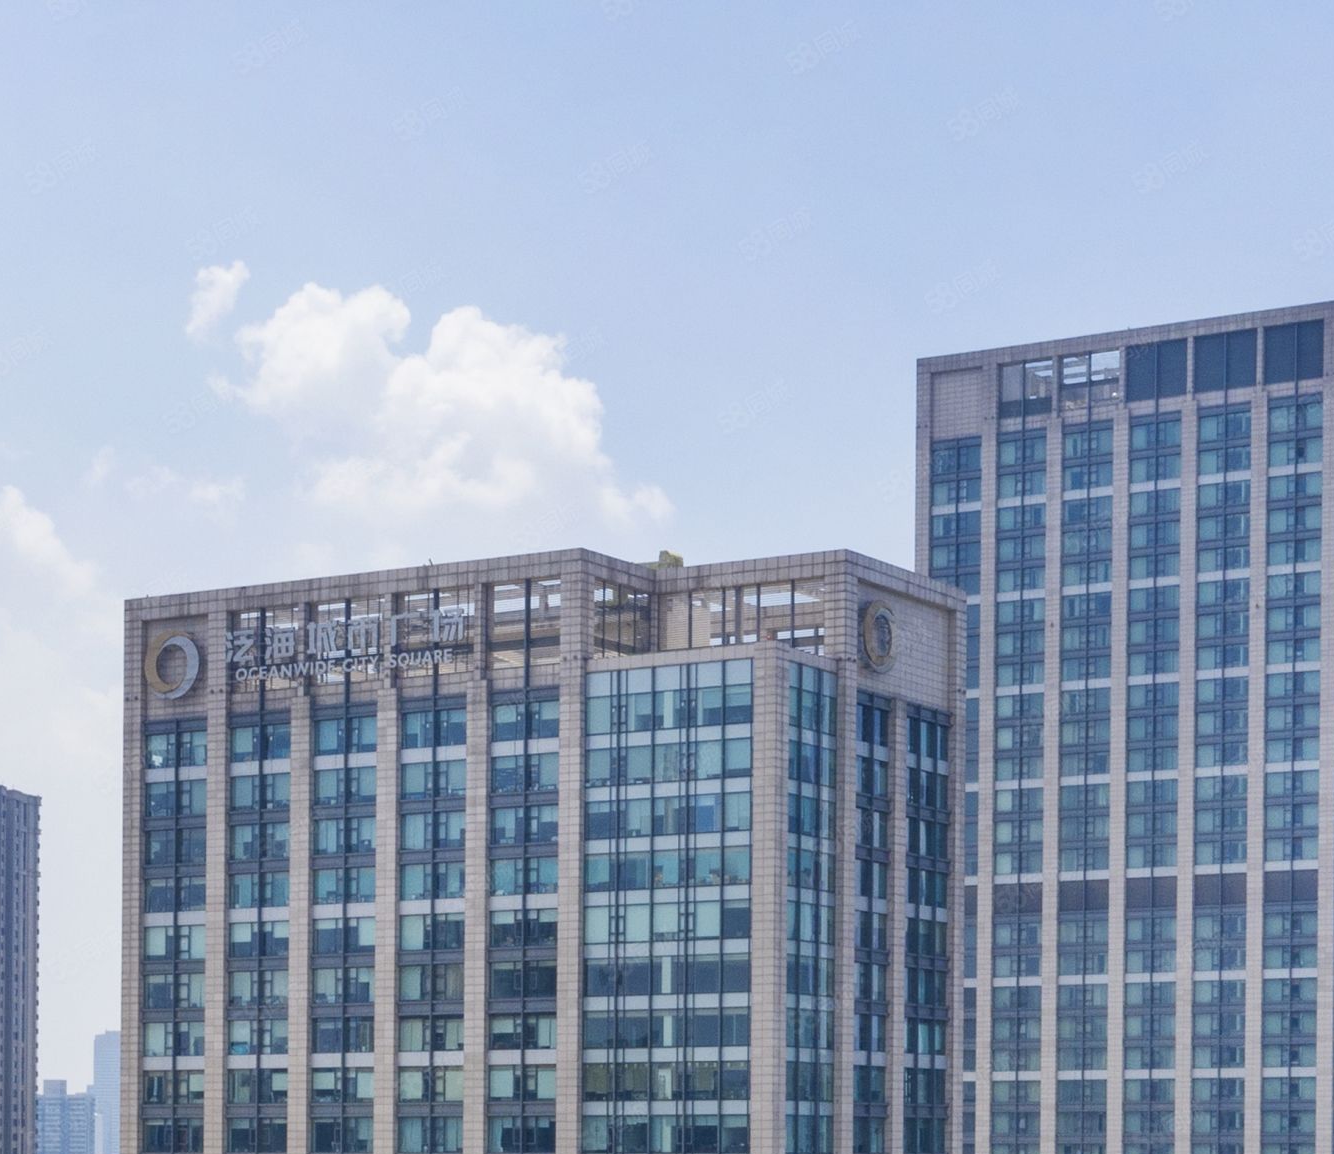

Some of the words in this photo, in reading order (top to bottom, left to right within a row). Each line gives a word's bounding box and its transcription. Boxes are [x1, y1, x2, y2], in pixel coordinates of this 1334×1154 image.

[225, 608, 465, 664] 泛海城市广场
[235, 660, 336, 682] OCEANWIDE
[342, 656, 379, 674] CITY
[388, 648, 454, 669] SQUARE
